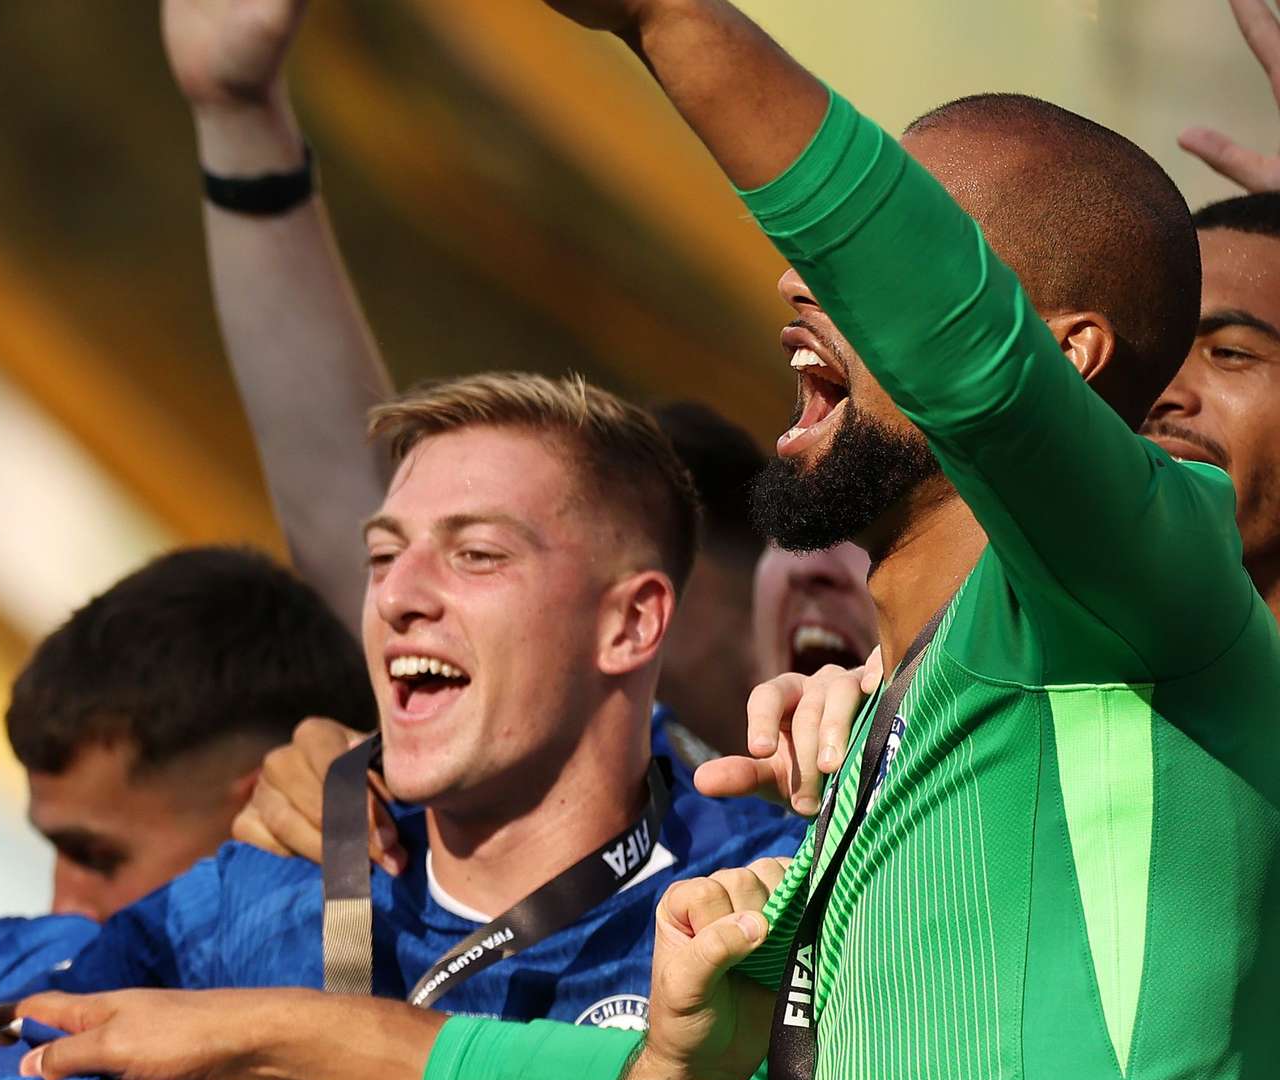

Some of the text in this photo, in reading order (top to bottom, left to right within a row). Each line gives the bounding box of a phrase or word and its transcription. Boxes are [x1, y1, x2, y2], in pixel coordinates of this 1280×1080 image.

[488, 927, 515, 951] FIFA
[447, 947, 484, 975] CLUB
[783, 944, 814, 1028] FIFA
[589, 1000, 648, 1024] CHELS
